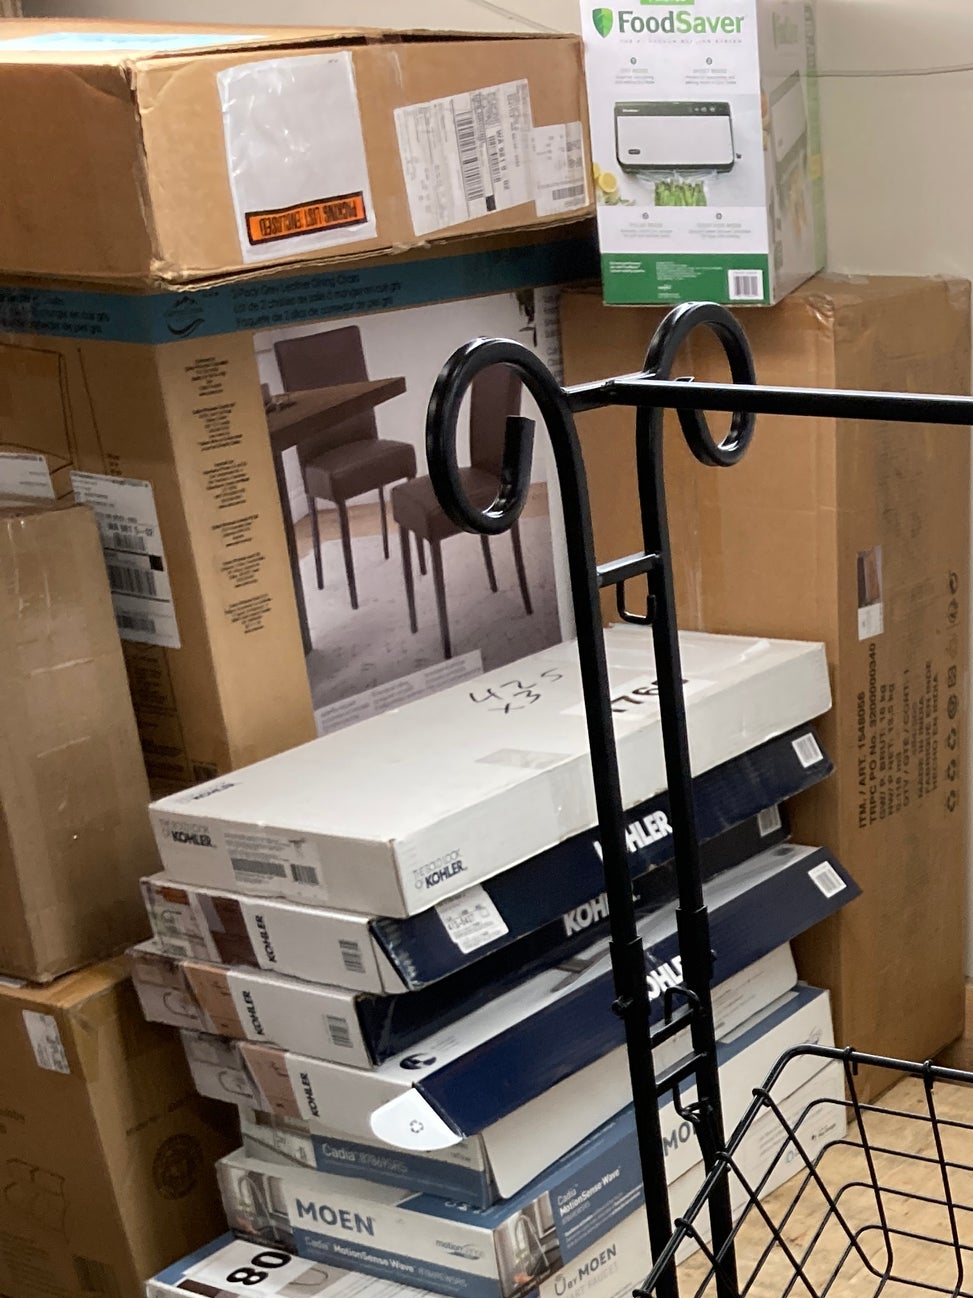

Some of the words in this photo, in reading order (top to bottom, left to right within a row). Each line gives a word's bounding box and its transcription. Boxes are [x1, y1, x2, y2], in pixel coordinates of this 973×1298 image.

[618, 11, 744, 34] FoodSaver
[868, 758, 878, 782] PO
[592, 810, 673, 862] HLER
[424, 859, 465, 889] KOHLER
[255, 914, 278, 964] KOHLER
[241, 990, 265, 1036] KOHLER
[299, 1072, 320, 1118] KOHLER
[322, 1143, 357, 1163] Cadia
[662, 1121, 699, 1157] MO
[557, 1187, 578, 1206] Cadia
[559, 1181, 603, 1217] MotionSense
[602, 1168, 622, 1186] Wave
[296, 1198, 375, 1237] MOEN
[333, 1243, 390, 1267] MotionSense
[389, 1258, 415, 1273] Wave
[578, 1244, 617, 1281] MOEN
